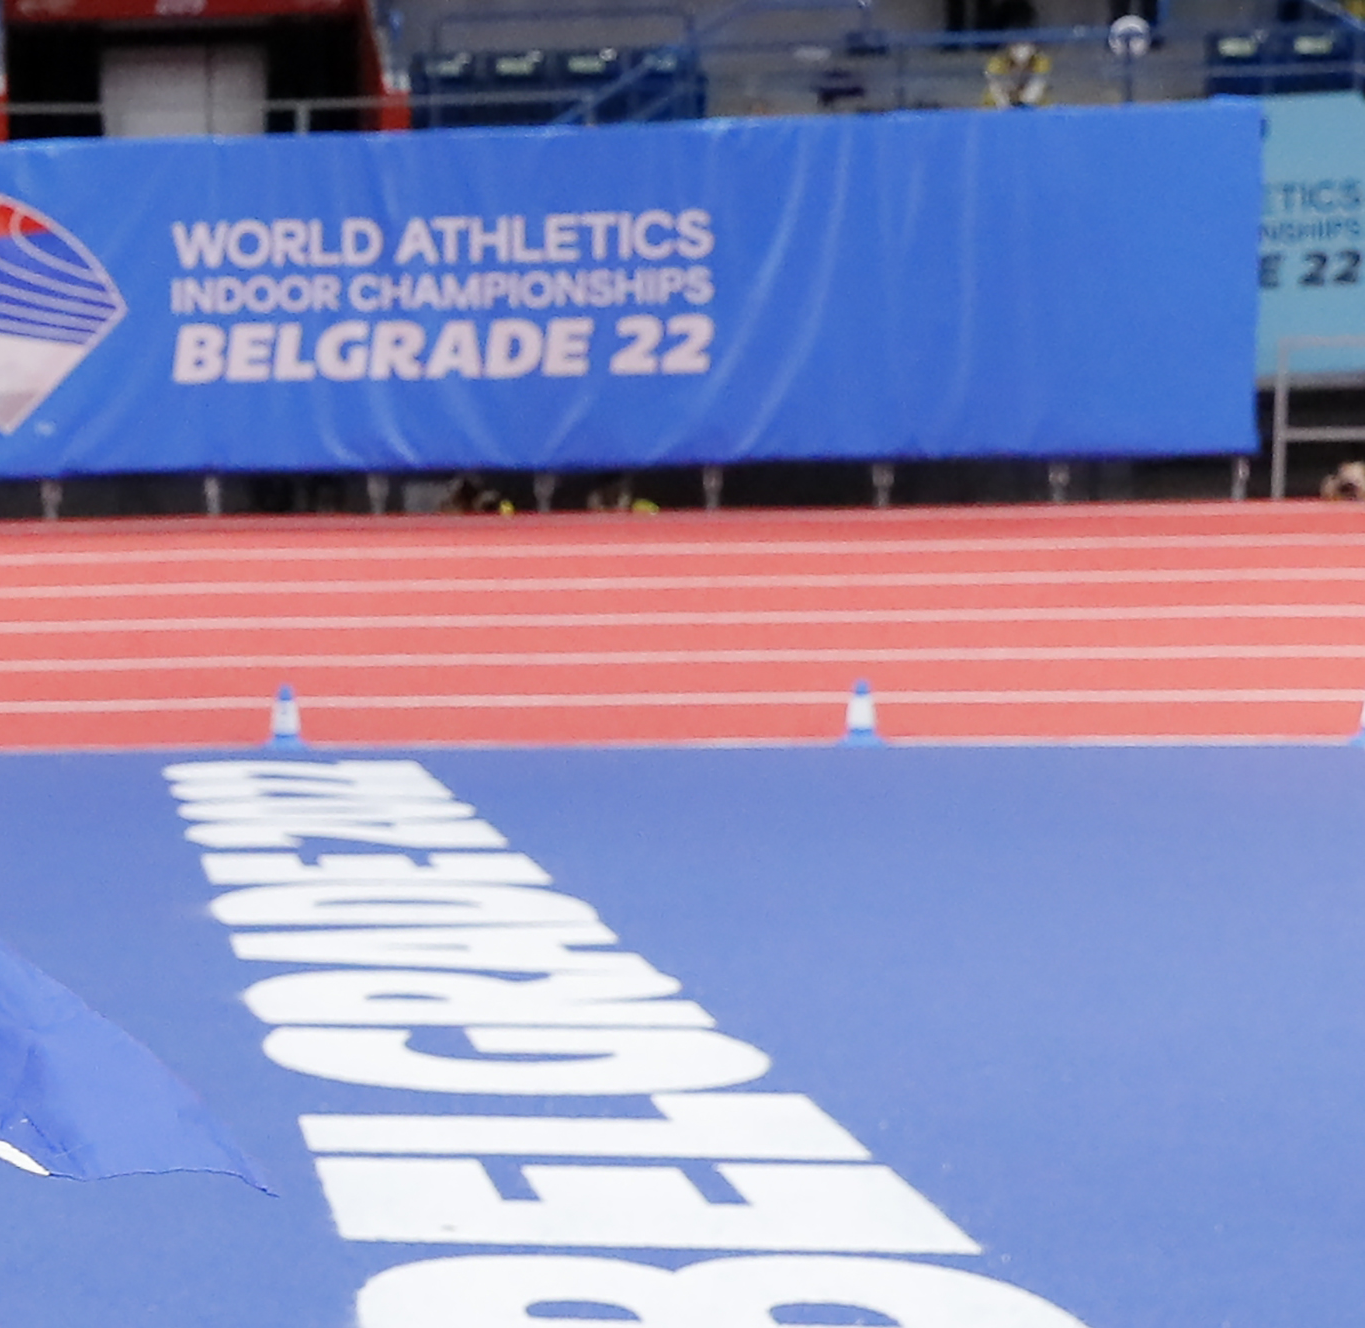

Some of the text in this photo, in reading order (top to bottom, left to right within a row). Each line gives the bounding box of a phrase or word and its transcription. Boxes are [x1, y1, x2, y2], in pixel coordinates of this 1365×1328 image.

[172, 210, 715, 269] WORLD ATHLETICS
[171, 266, 715, 315] INDOOR CHAMPIONSHIPS
[1298, 248, 1361, 286] 22
[172, 313, 715, 384] BELGRADE 22
